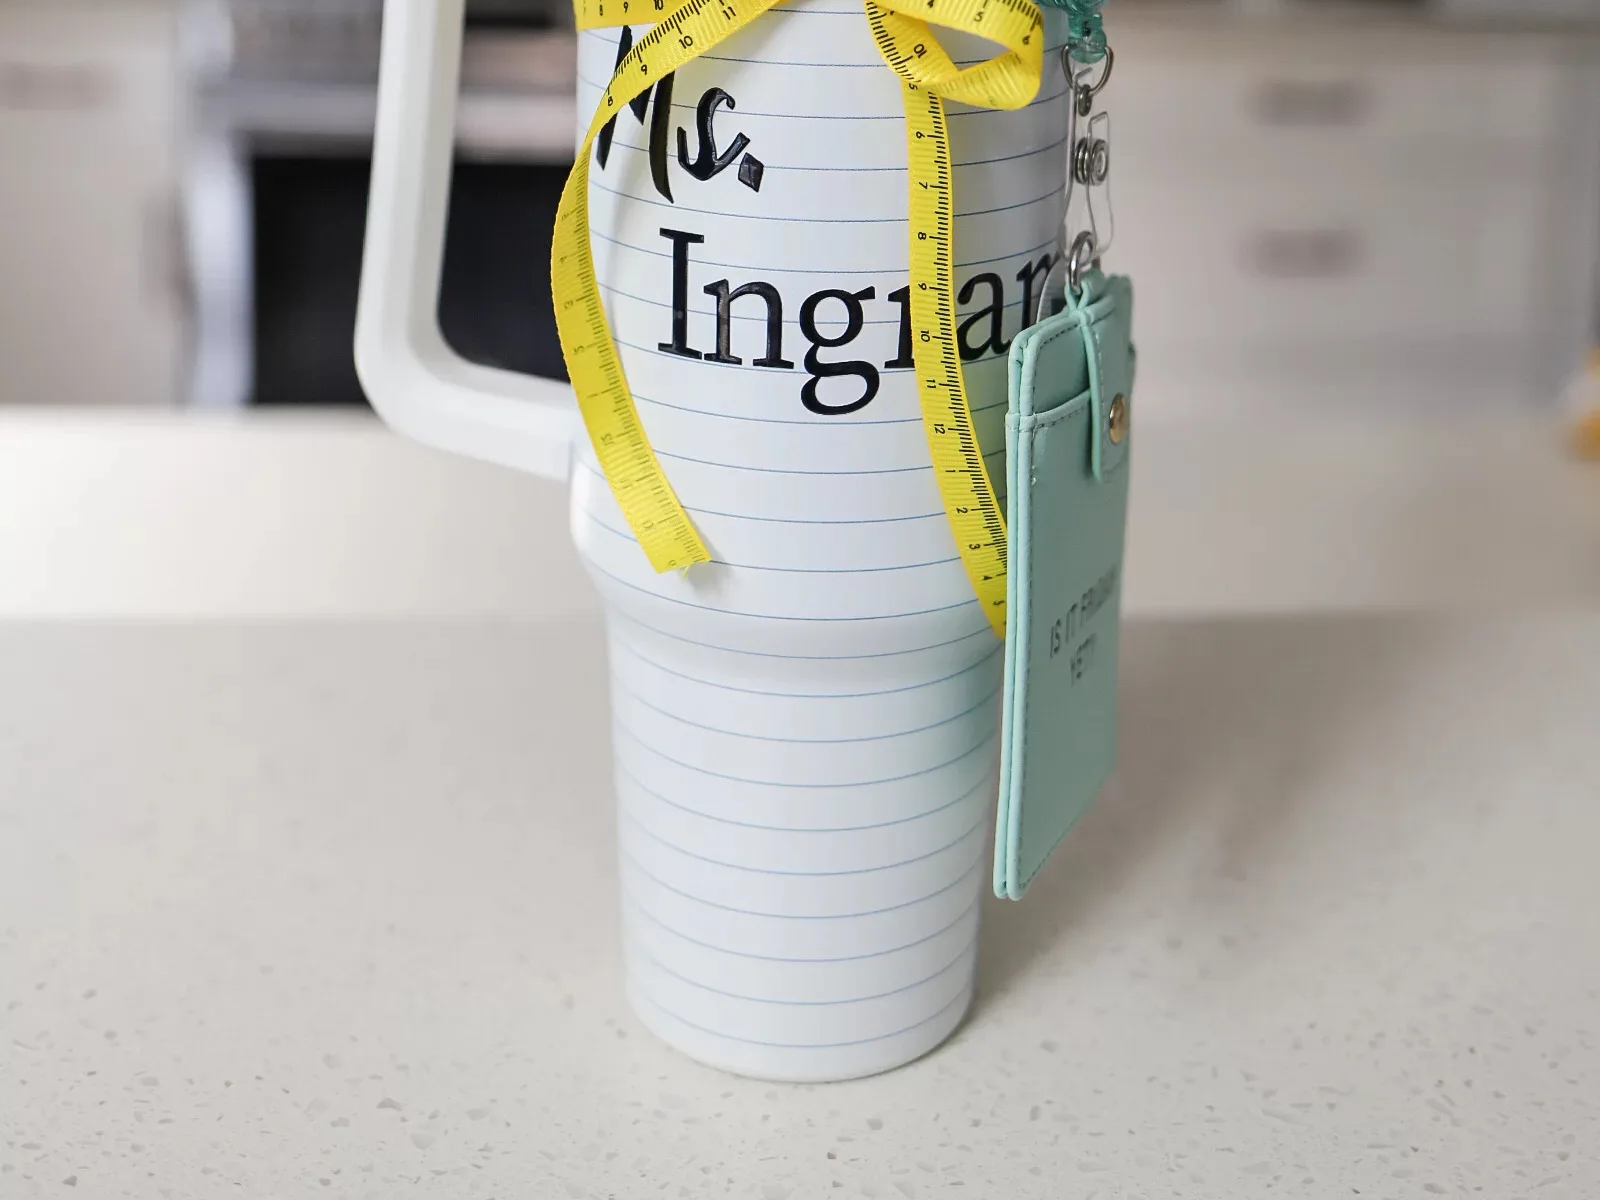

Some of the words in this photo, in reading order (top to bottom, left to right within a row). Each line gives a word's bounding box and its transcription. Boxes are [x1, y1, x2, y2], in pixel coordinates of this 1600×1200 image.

[622, 2, 628, 14] 9
[974, 10, 983, 22] 5
[640, 64, 648, 76] 9
[678, 35, 694, 50] 10
[722, 6, 736, 20] 11
[913, 42, 928, 59] 10
[916, 131, 926, 139] 6
[918, 182, 928, 190] 7
[918, 232, 927, 240] 8
[918, 282, 927, 290] 9
[920, 330, 930, 342] 10
[926, 378, 937, 390] 11
[934, 423, 946, 435] 12
[956, 506, 968, 514] 2
